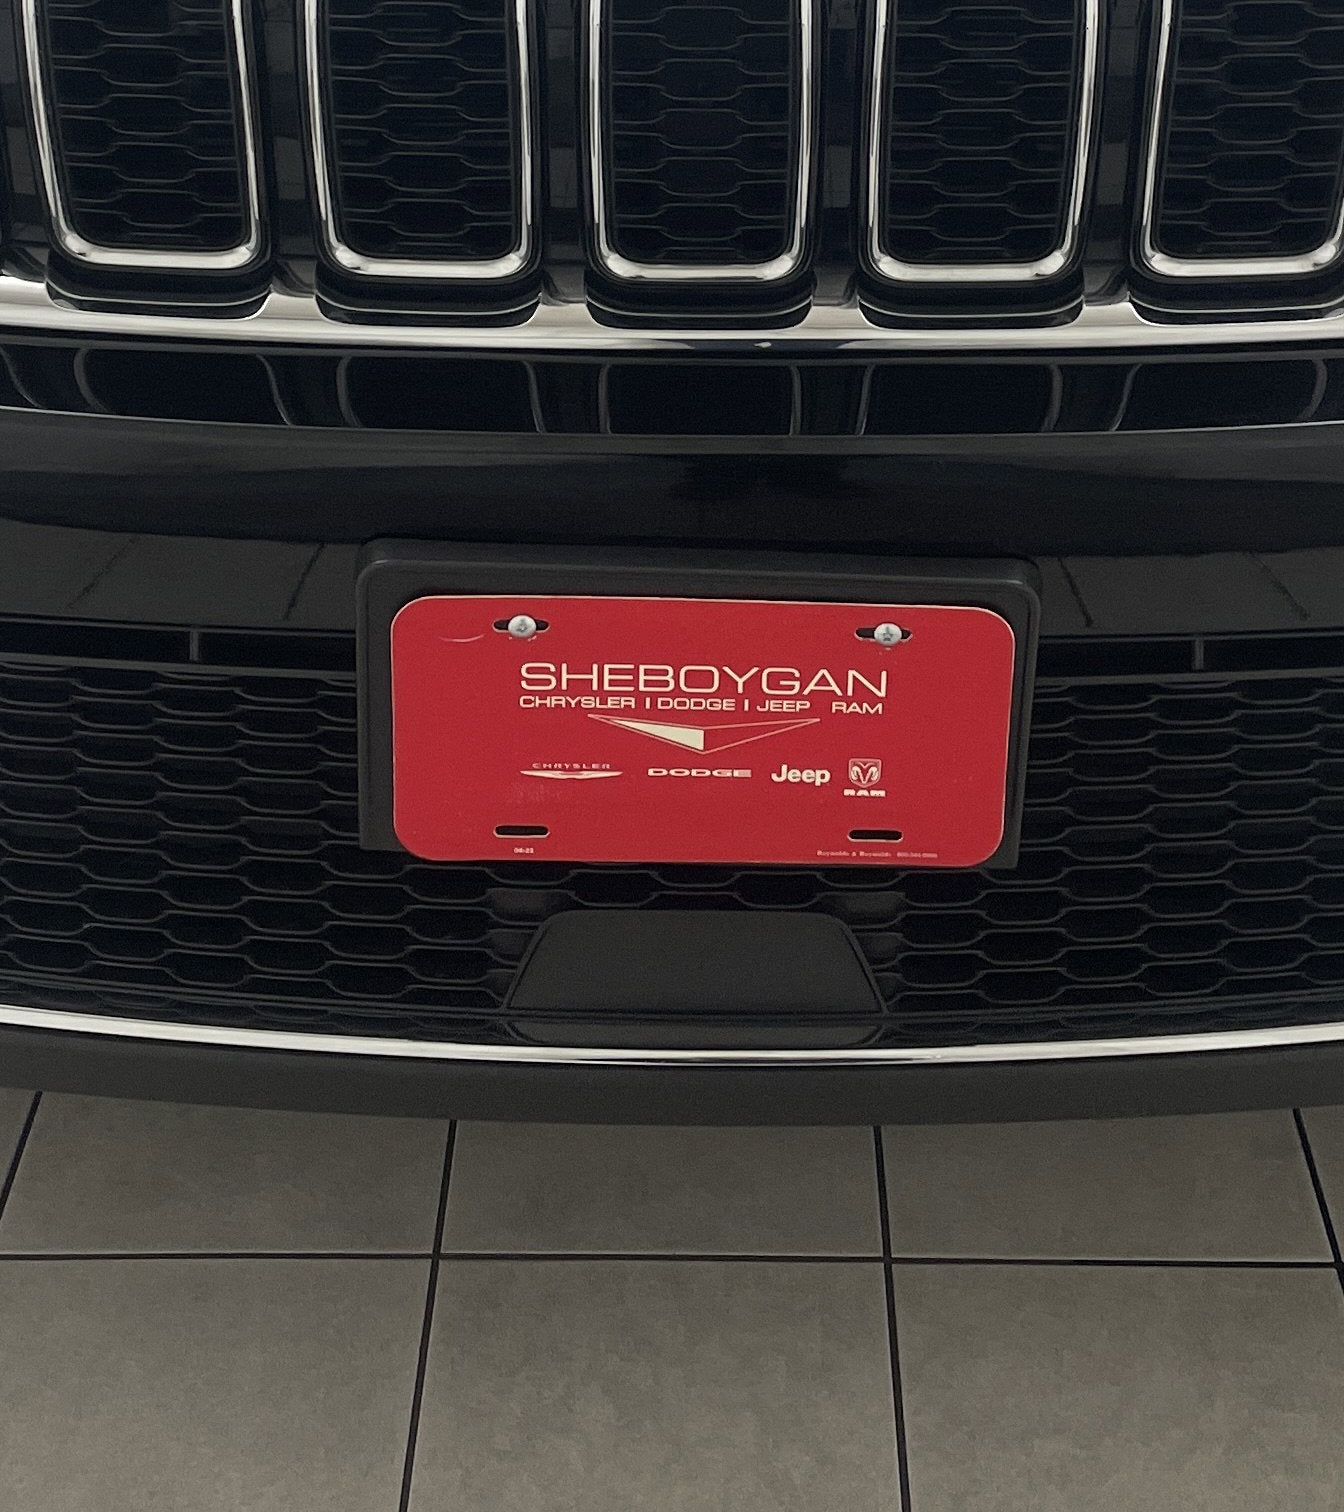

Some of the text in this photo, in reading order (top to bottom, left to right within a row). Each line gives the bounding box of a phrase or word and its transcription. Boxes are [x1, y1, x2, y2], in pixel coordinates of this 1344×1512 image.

[520, 662, 888, 698] SHEBOYGAN
[519, 695, 636, 710] CHRYSLER
[657, 697, 736, 711] DODGE
[756, 699, 811, 713] JEEP
[831, 701, 883, 715] RAM
[531, 762, 611, 770] CHRYSLER
[647, 767, 752, 778] DODGE
[771, 763, 832, 787] Jeep
[843, 788, 886, 798] RAM
